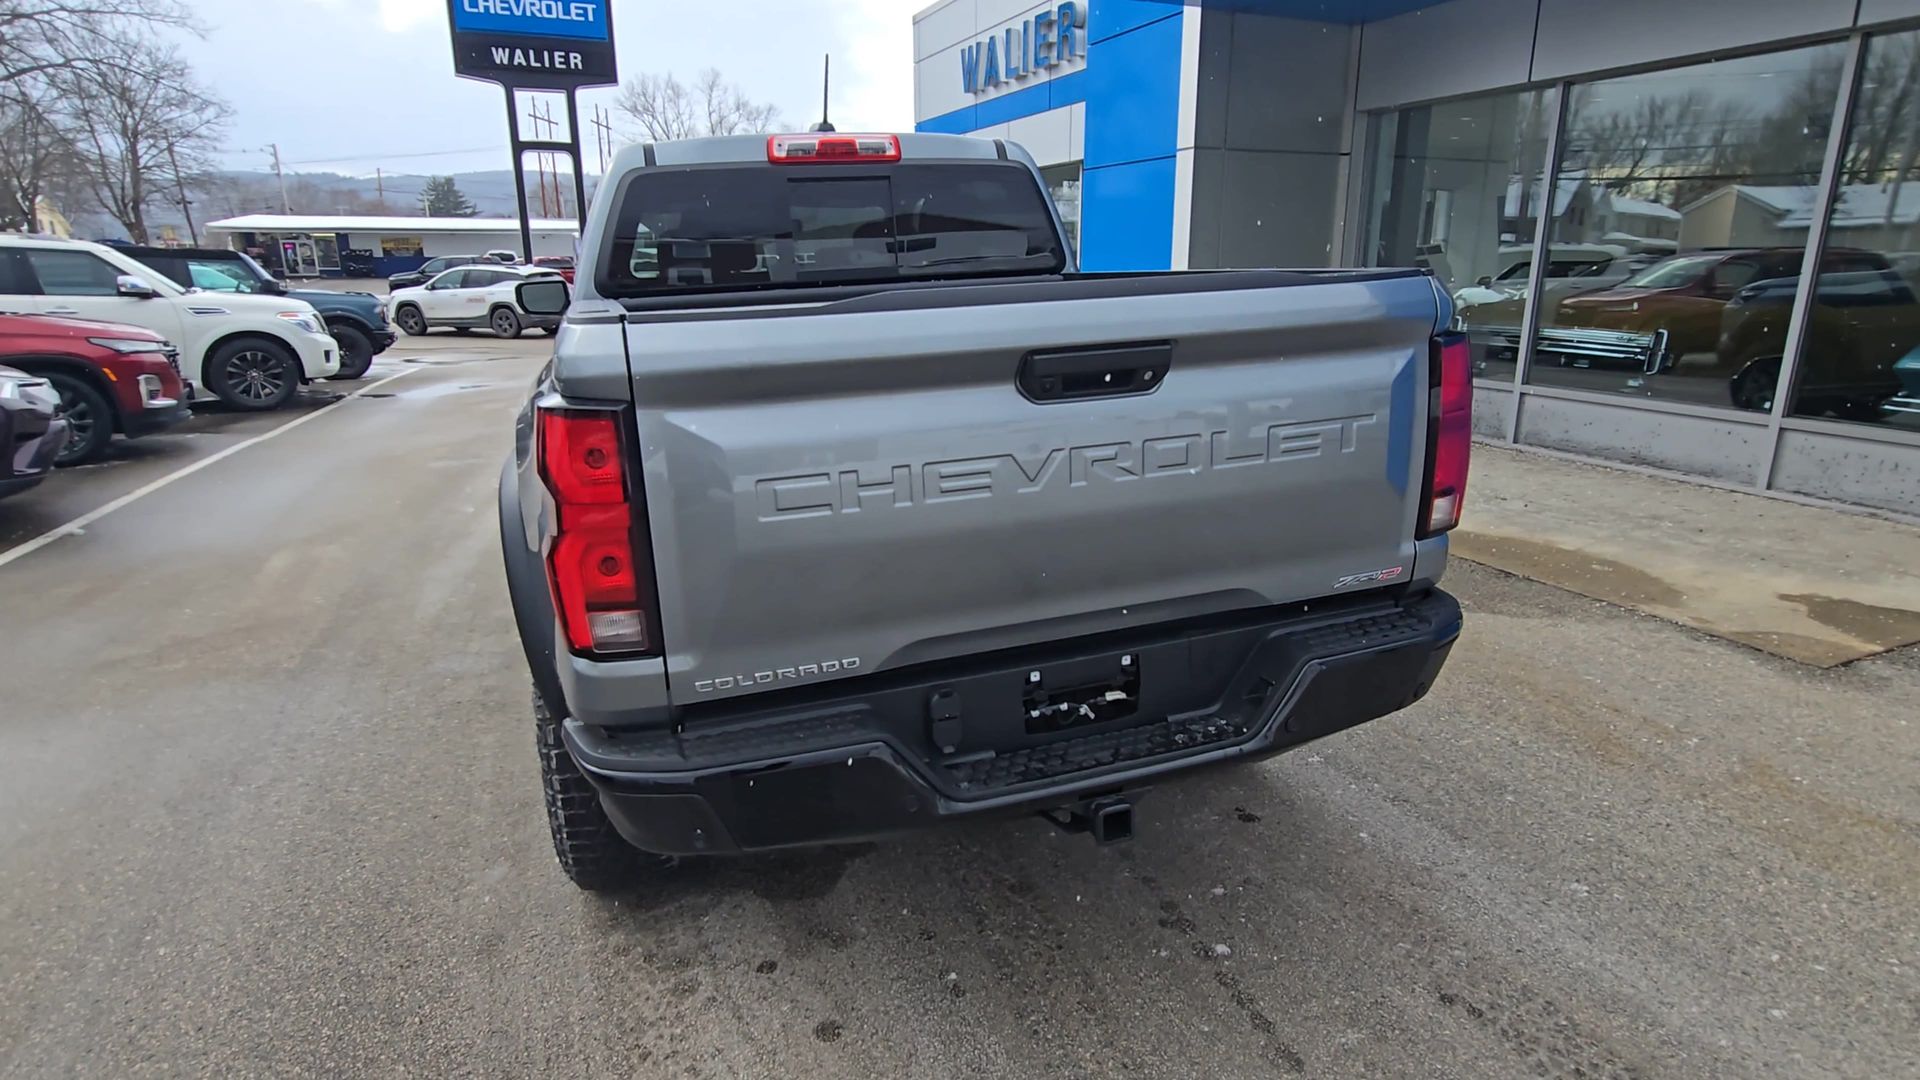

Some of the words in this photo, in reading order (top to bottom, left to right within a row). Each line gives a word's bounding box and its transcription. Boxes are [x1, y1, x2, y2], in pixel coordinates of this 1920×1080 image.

[463, 0, 597, 22] CHEVROLET
[491, 46, 583, 70] WALIER
[960, 1, 1086, 94] WALIER
[754, 413, 1377, 523] CHEVROLET
[694, 656, 861, 692] COLORADO
